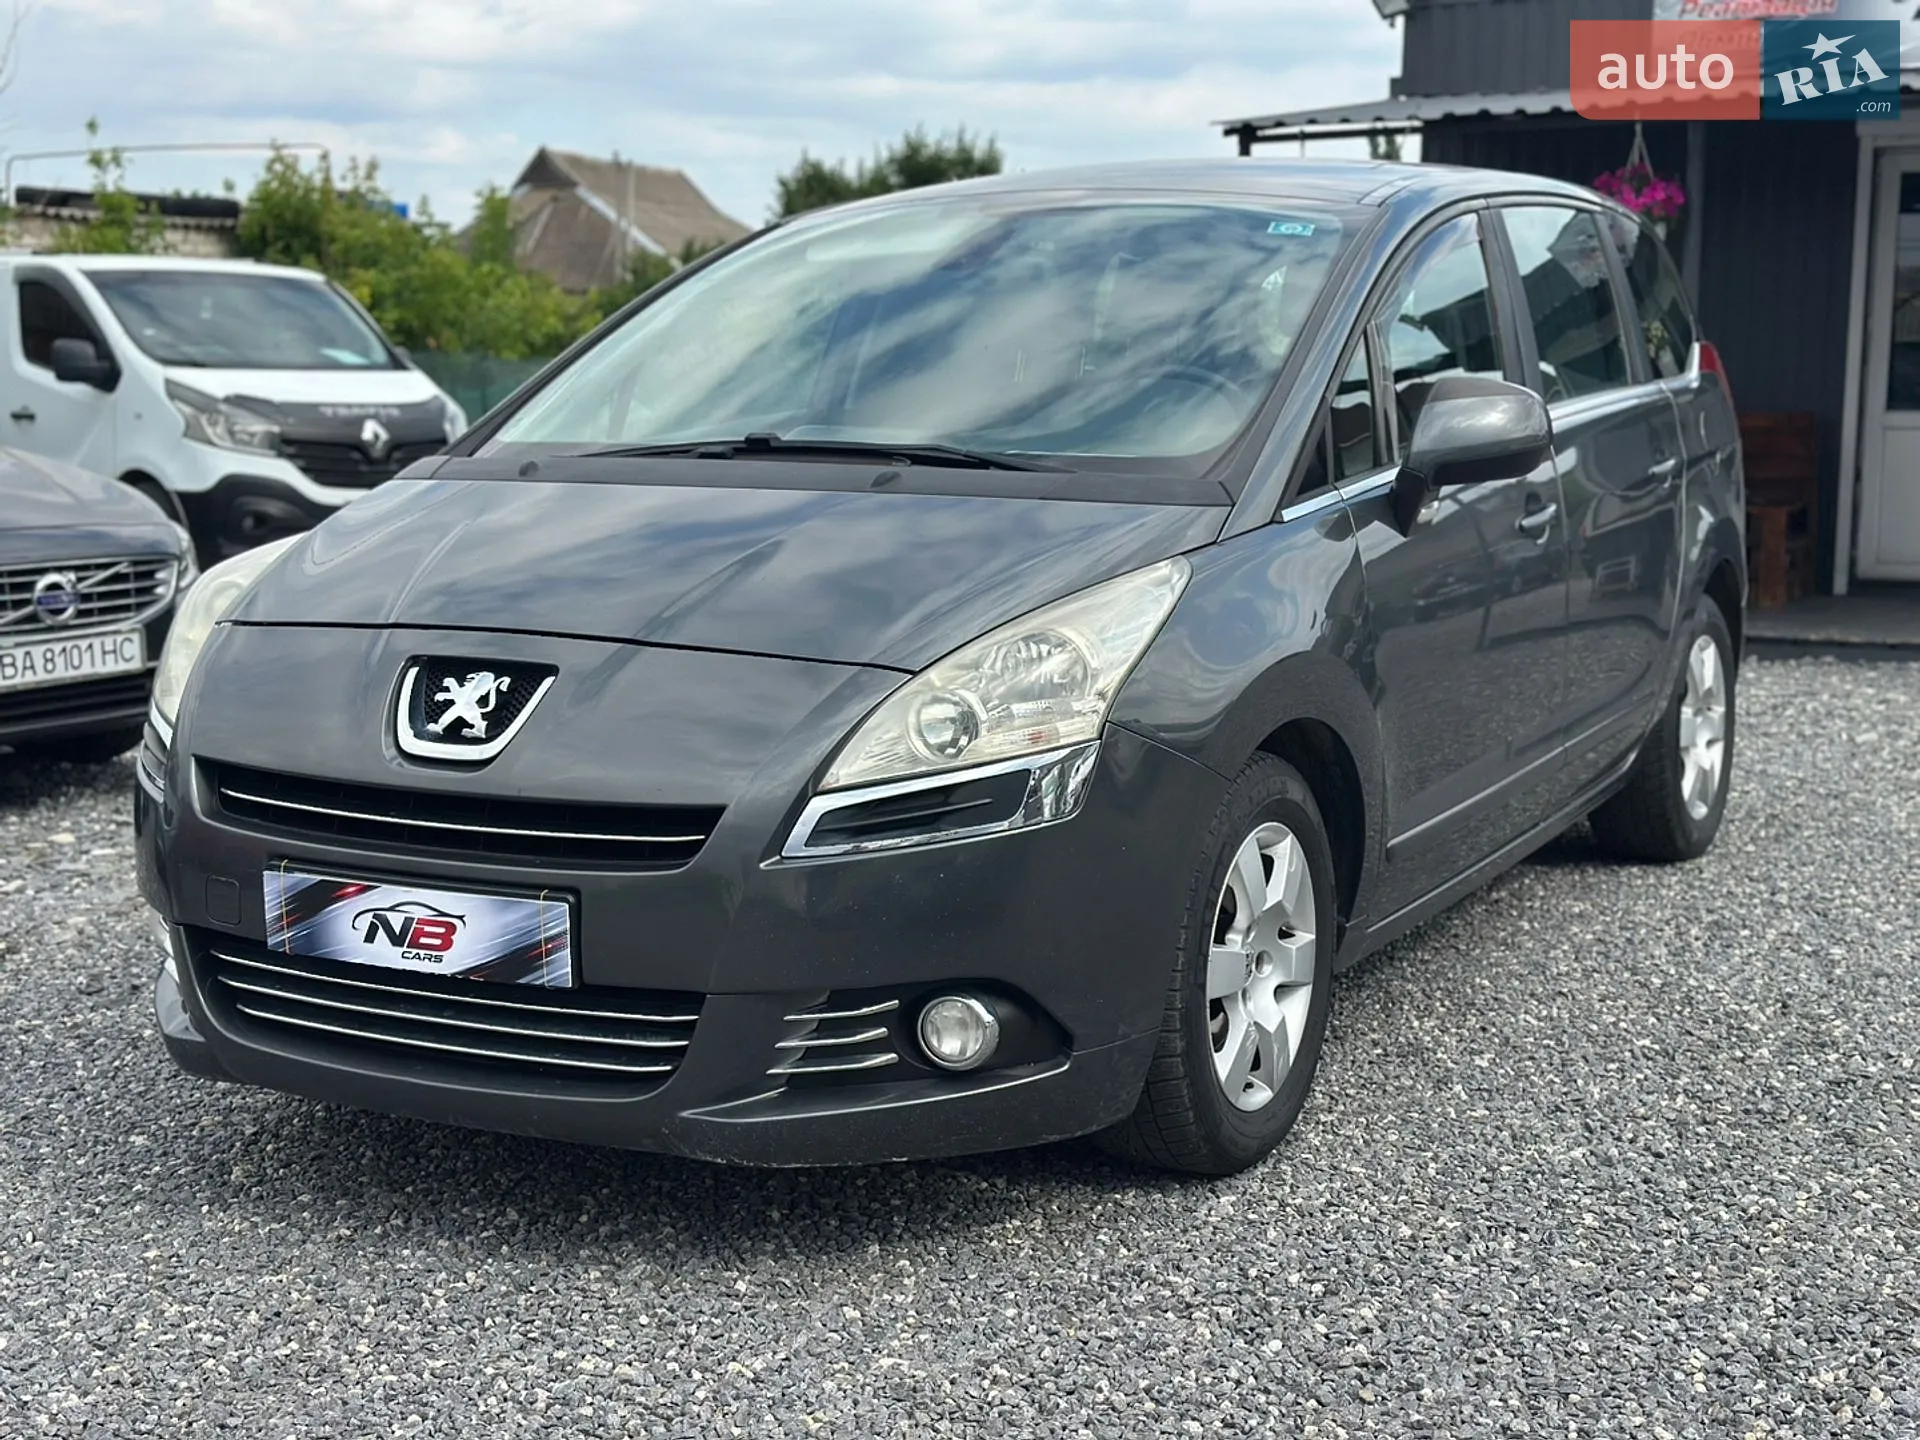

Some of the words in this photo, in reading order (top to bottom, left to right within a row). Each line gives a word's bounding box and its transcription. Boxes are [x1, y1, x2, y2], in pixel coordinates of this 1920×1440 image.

[42, 642, 96, 674] 8101
[362, 912, 458, 953] NB
[401, 950, 444, 964] CARS
